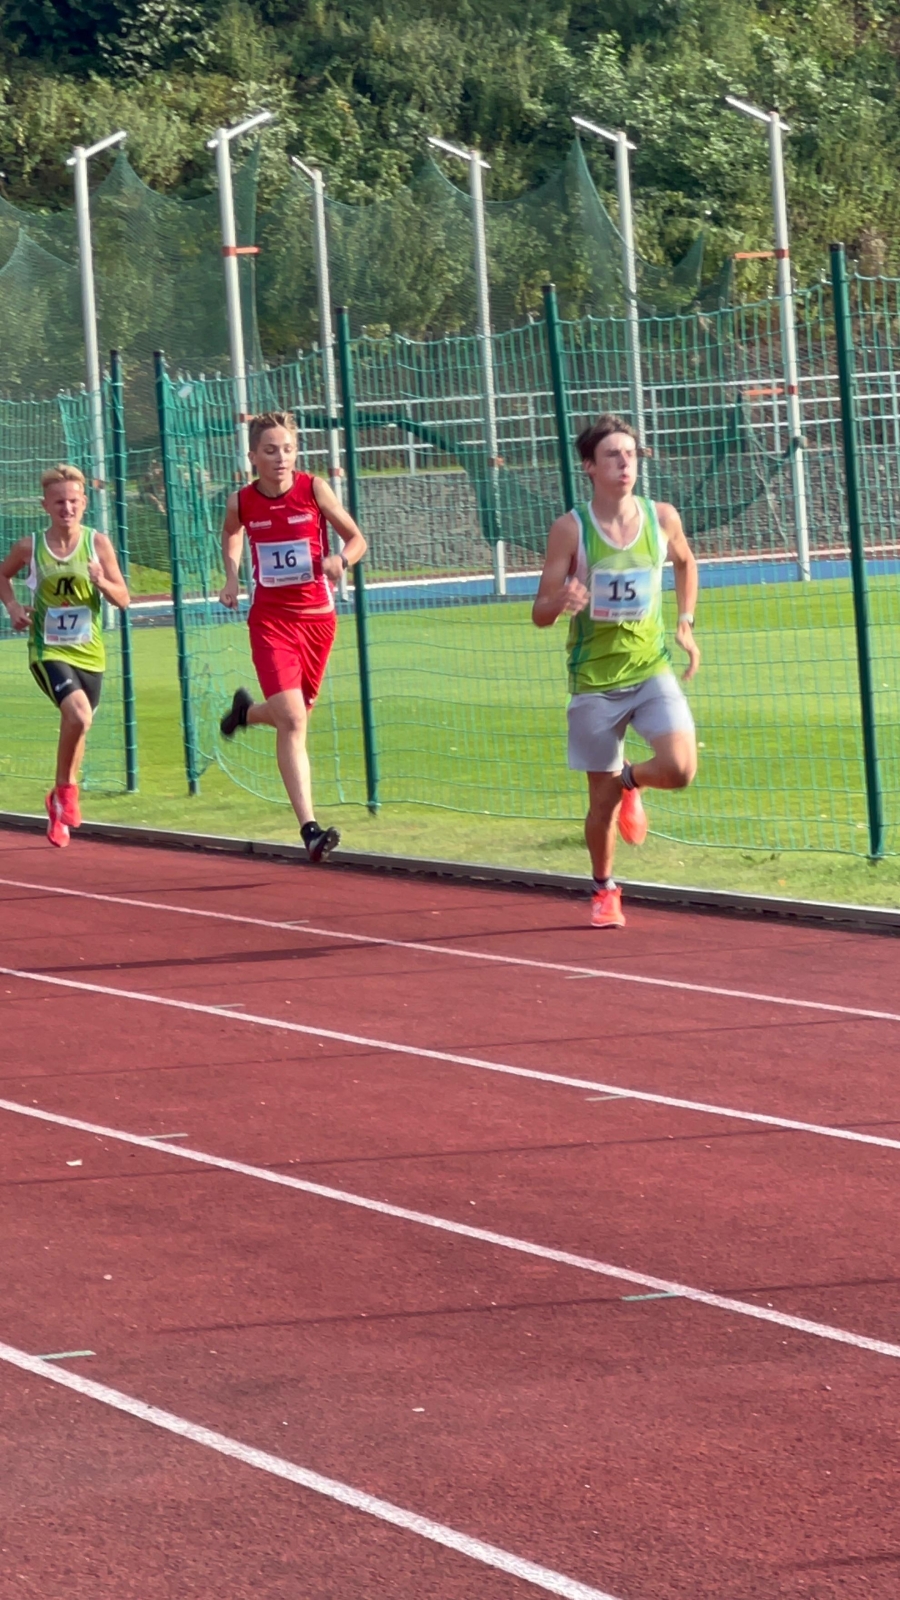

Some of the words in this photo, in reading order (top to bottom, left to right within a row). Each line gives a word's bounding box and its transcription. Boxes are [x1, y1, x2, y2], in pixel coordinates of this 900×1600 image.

[272, 550, 297, 570] 16
[608, 579, 637, 602] 15
[57, 614, 79, 631] 17
